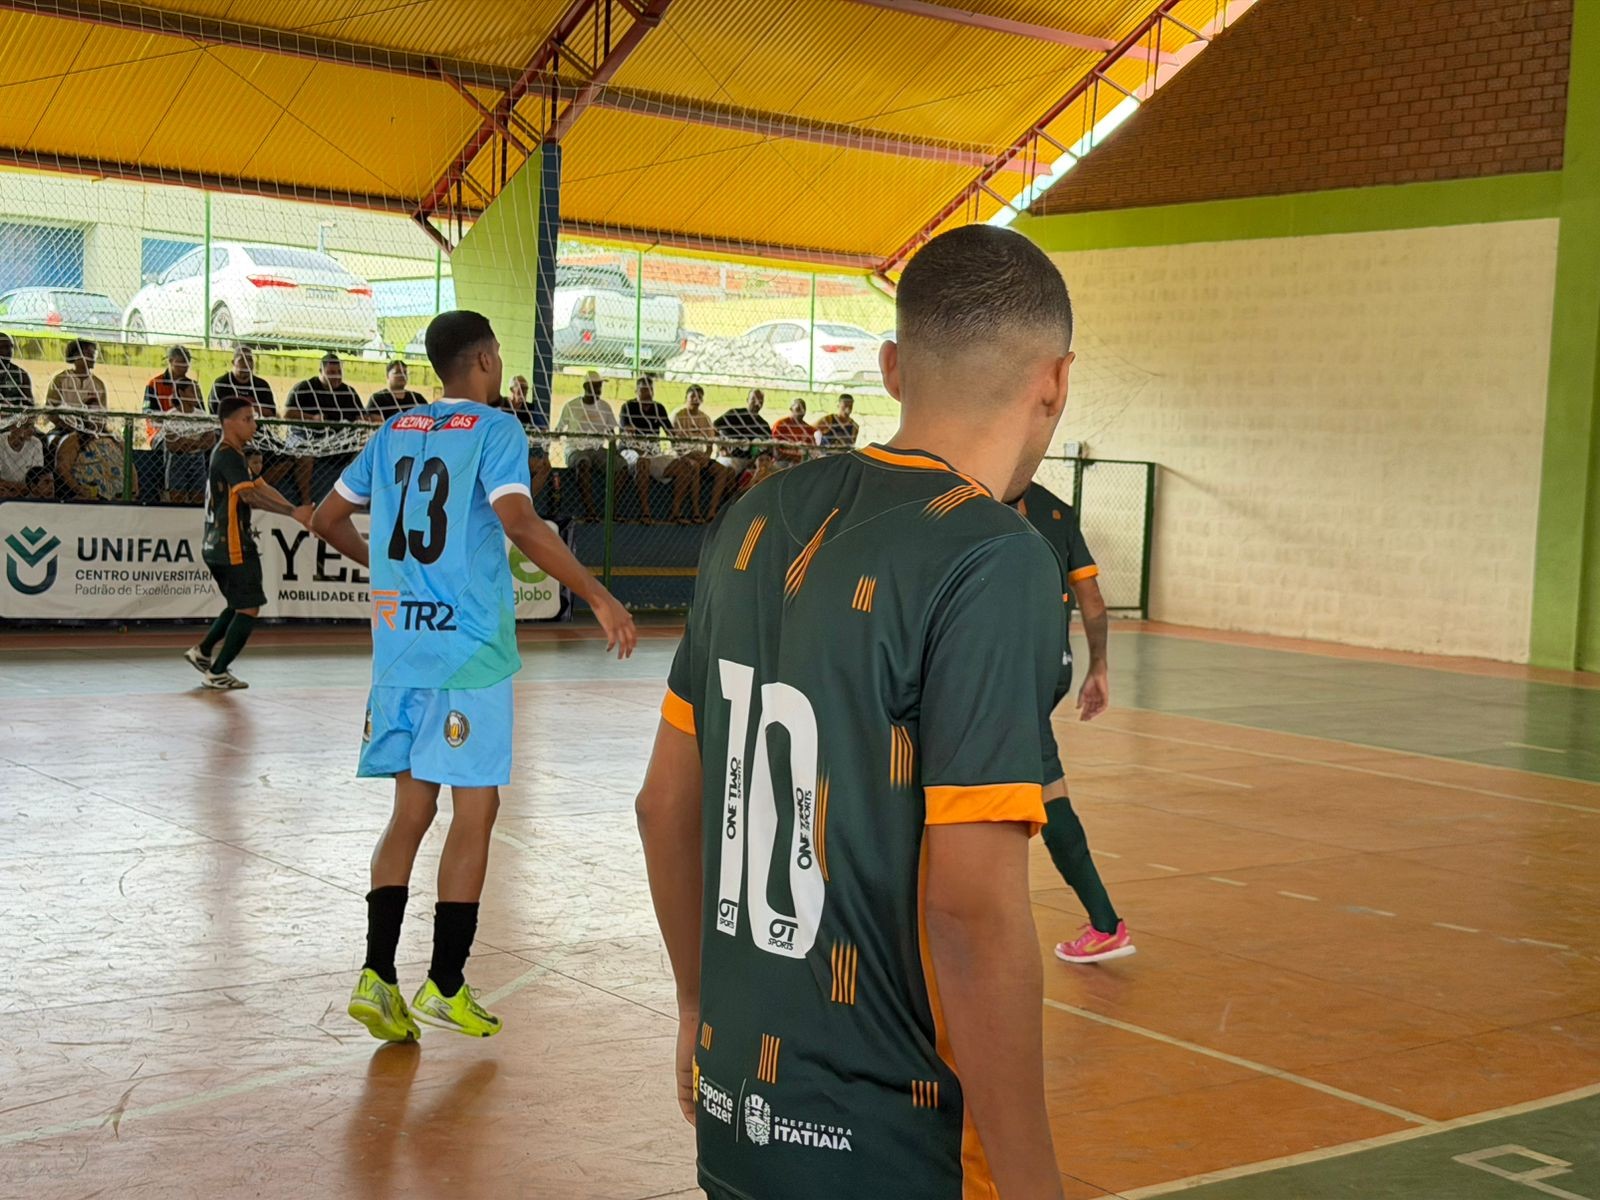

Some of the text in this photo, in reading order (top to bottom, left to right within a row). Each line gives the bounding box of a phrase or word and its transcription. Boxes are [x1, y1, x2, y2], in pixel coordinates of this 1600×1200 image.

[388, 455, 450, 565] 13
[77, 536, 195, 563] UNIFAA
[75, 569, 130, 581] CENTRO
[75, 583, 116, 596] Padrão
[117, 584, 132, 595] de
[135, 584, 191, 596] Excelência
[278, 590, 355, 602] MOBILIDADE
[400, 600, 457, 631] TR2
[716, 658, 825, 959] 10
[726, 803, 737, 840] ONE
[768, 938, 794, 951] SPORTS
[699, 1076, 734, 1111] Esporte
[706, 1099, 733, 1125] Lazer
[774, 1116, 853, 1136] PREFEITURA
[774, 1125, 853, 1152] ITATIAIA
